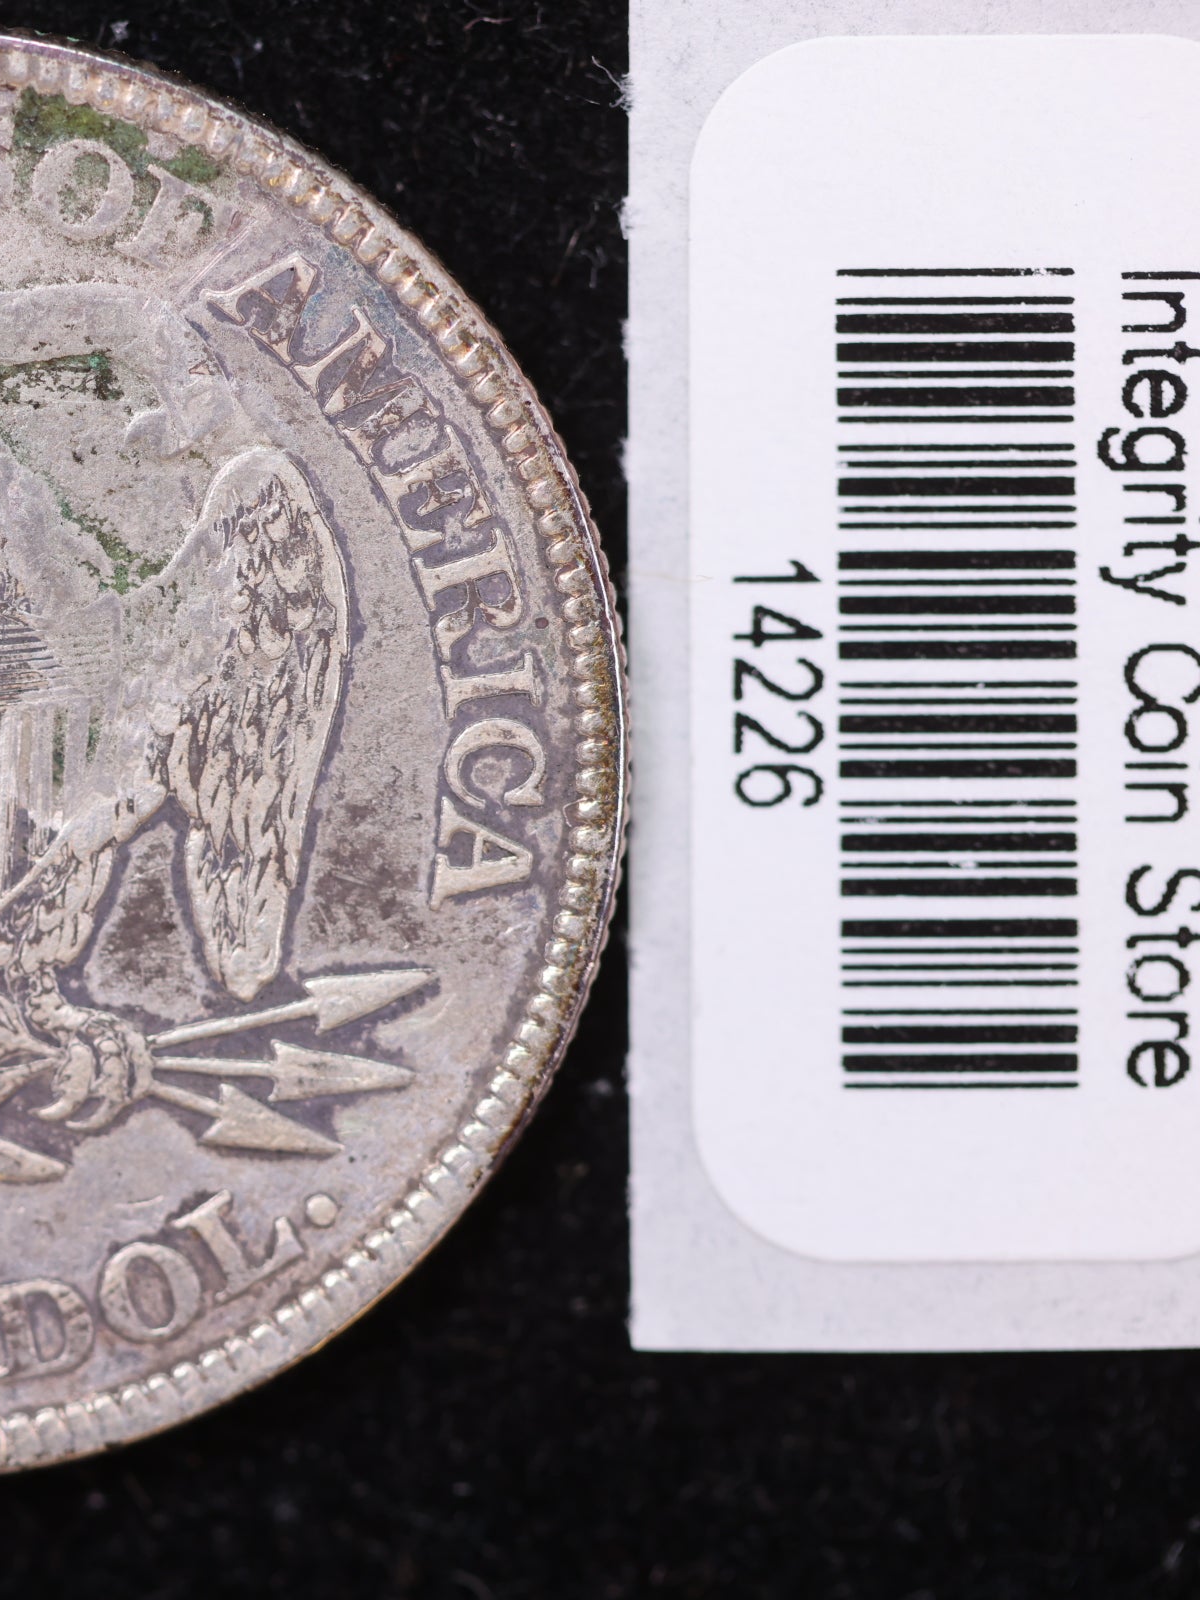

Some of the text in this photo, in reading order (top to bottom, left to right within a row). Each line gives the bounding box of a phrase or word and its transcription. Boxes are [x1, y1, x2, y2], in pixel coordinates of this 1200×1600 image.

[32, 138, 216, 267] OF
[202, 253, 547, 902] AMERICA
[733, 560, 825, 808] 14226
[1098, 271, 1200, 1088] Integrity Coin Store
